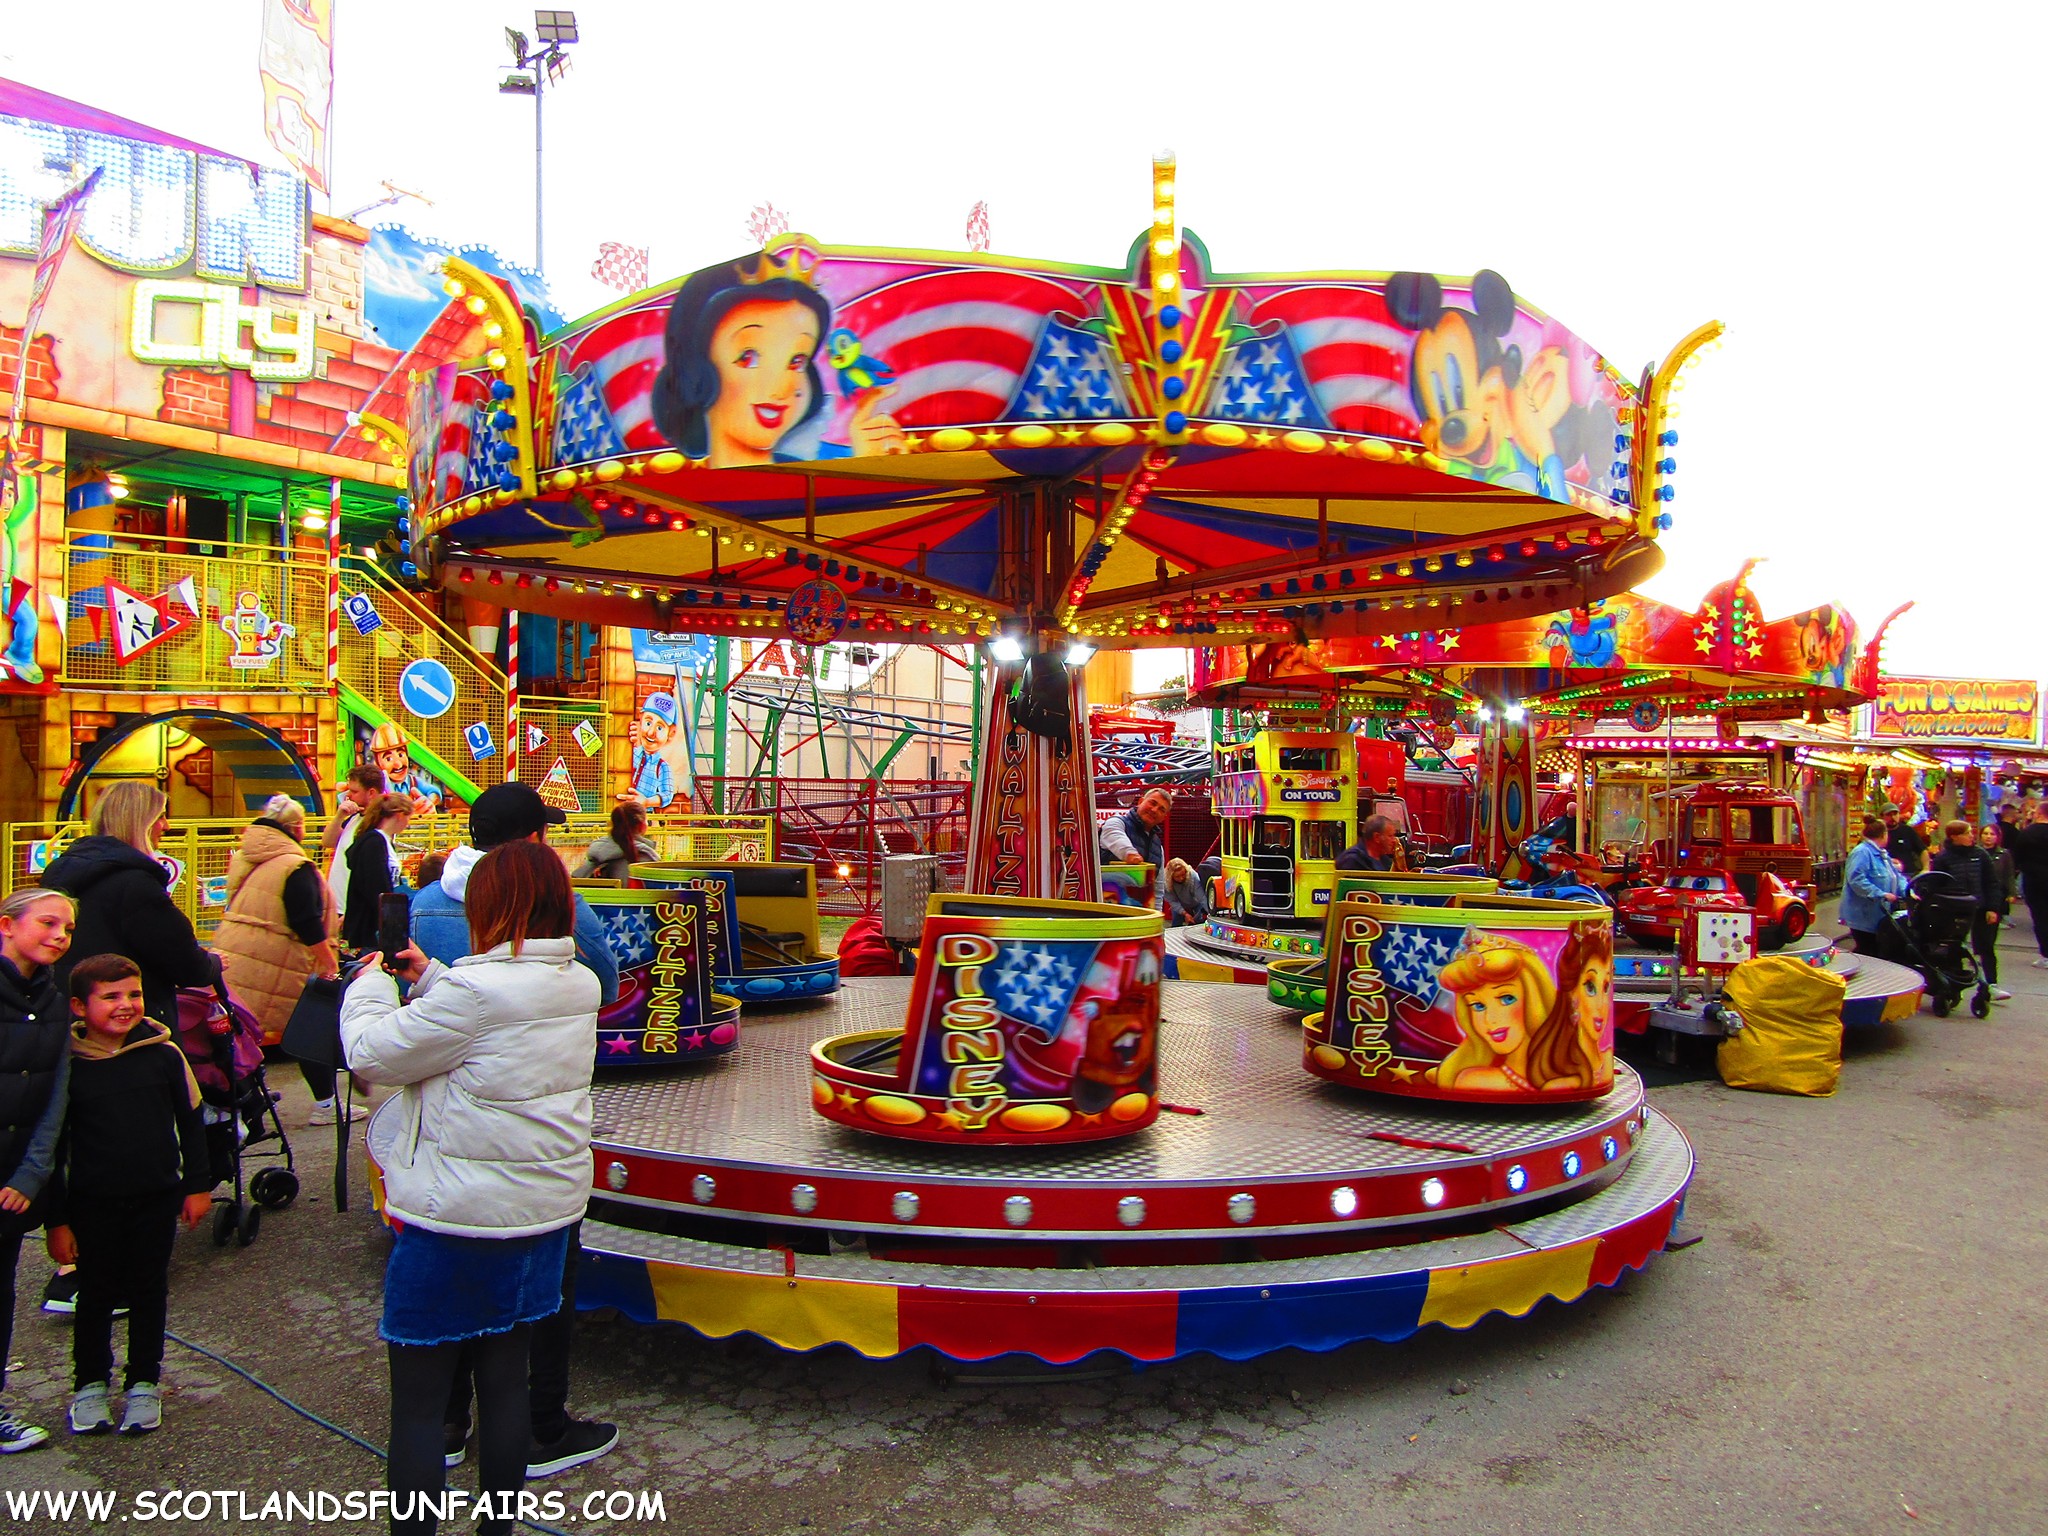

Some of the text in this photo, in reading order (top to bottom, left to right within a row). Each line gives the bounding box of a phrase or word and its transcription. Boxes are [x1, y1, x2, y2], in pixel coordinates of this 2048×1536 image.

[0, 112, 312, 295] FUN
[1877, 681, 2034, 712] FUN & GAMES
[1904, 714, 1935, 736] FOR
[542, 780, 573, 790] BARRELS
[546, 788, 559, 796] FUN
[1285, 791, 1335, 800] ON TOUR
[541, 796, 577, 809] VERYONE
[1314, 893, 1329, 901] FUN
[642, 901, 698, 1054] WALTZER
[1343, 916, 1393, 1077] DISNEY
[937, 934, 1009, 1129] DISNEY
